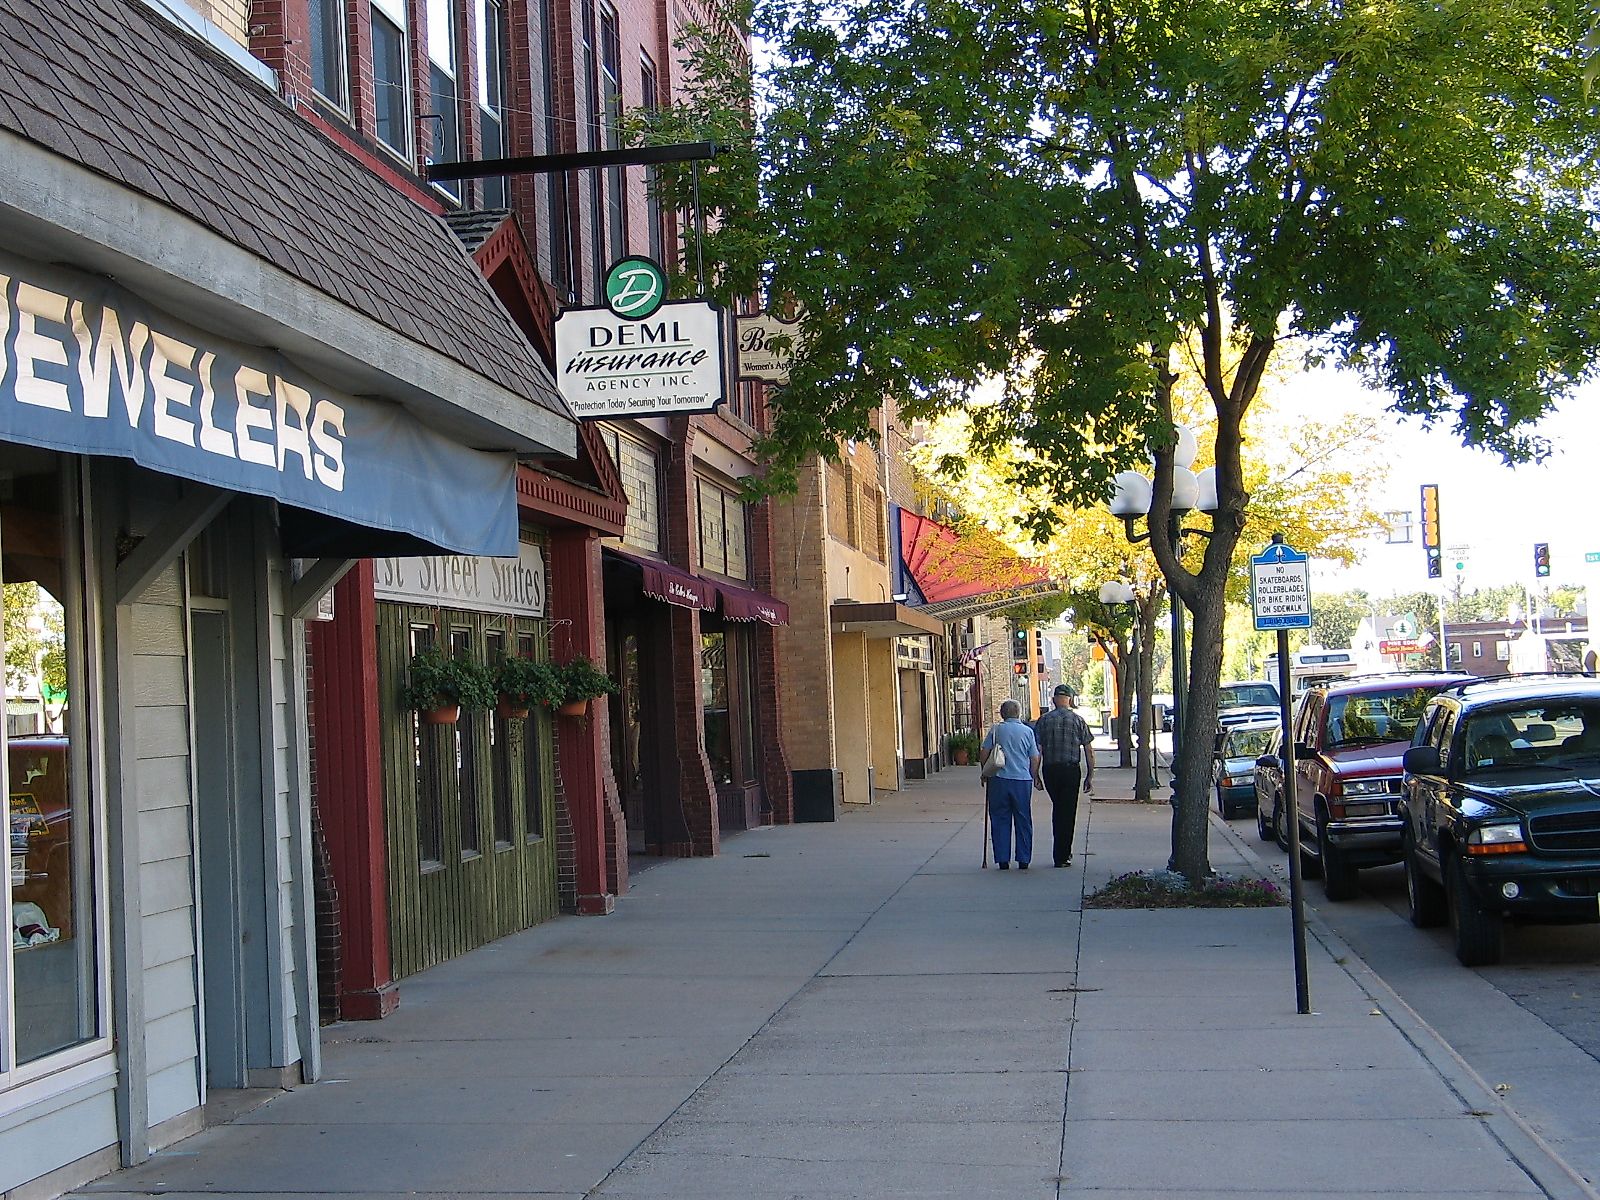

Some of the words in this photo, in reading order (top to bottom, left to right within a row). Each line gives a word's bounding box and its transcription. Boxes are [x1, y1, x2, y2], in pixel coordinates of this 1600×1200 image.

[589, 321, 691, 348] DEML
[565, 348, 709, 375] insurance
[744, 362, 774, 371] Women's
[0, 274, 347, 492] EWELERS
[586, 377, 652, 392] AGENCY
[662, 375, 697, 387] INC.
[607, 398, 626, 410] Today
[628, 397, 656, 408] Securing
[657, 395, 672, 405] Your
[419, 556, 481, 598] Street
[491, 557, 540, 607] Suites
[1259, 585, 1304, 594] ROLLERBLADES
[1285, 594, 1306, 603] RIDING
